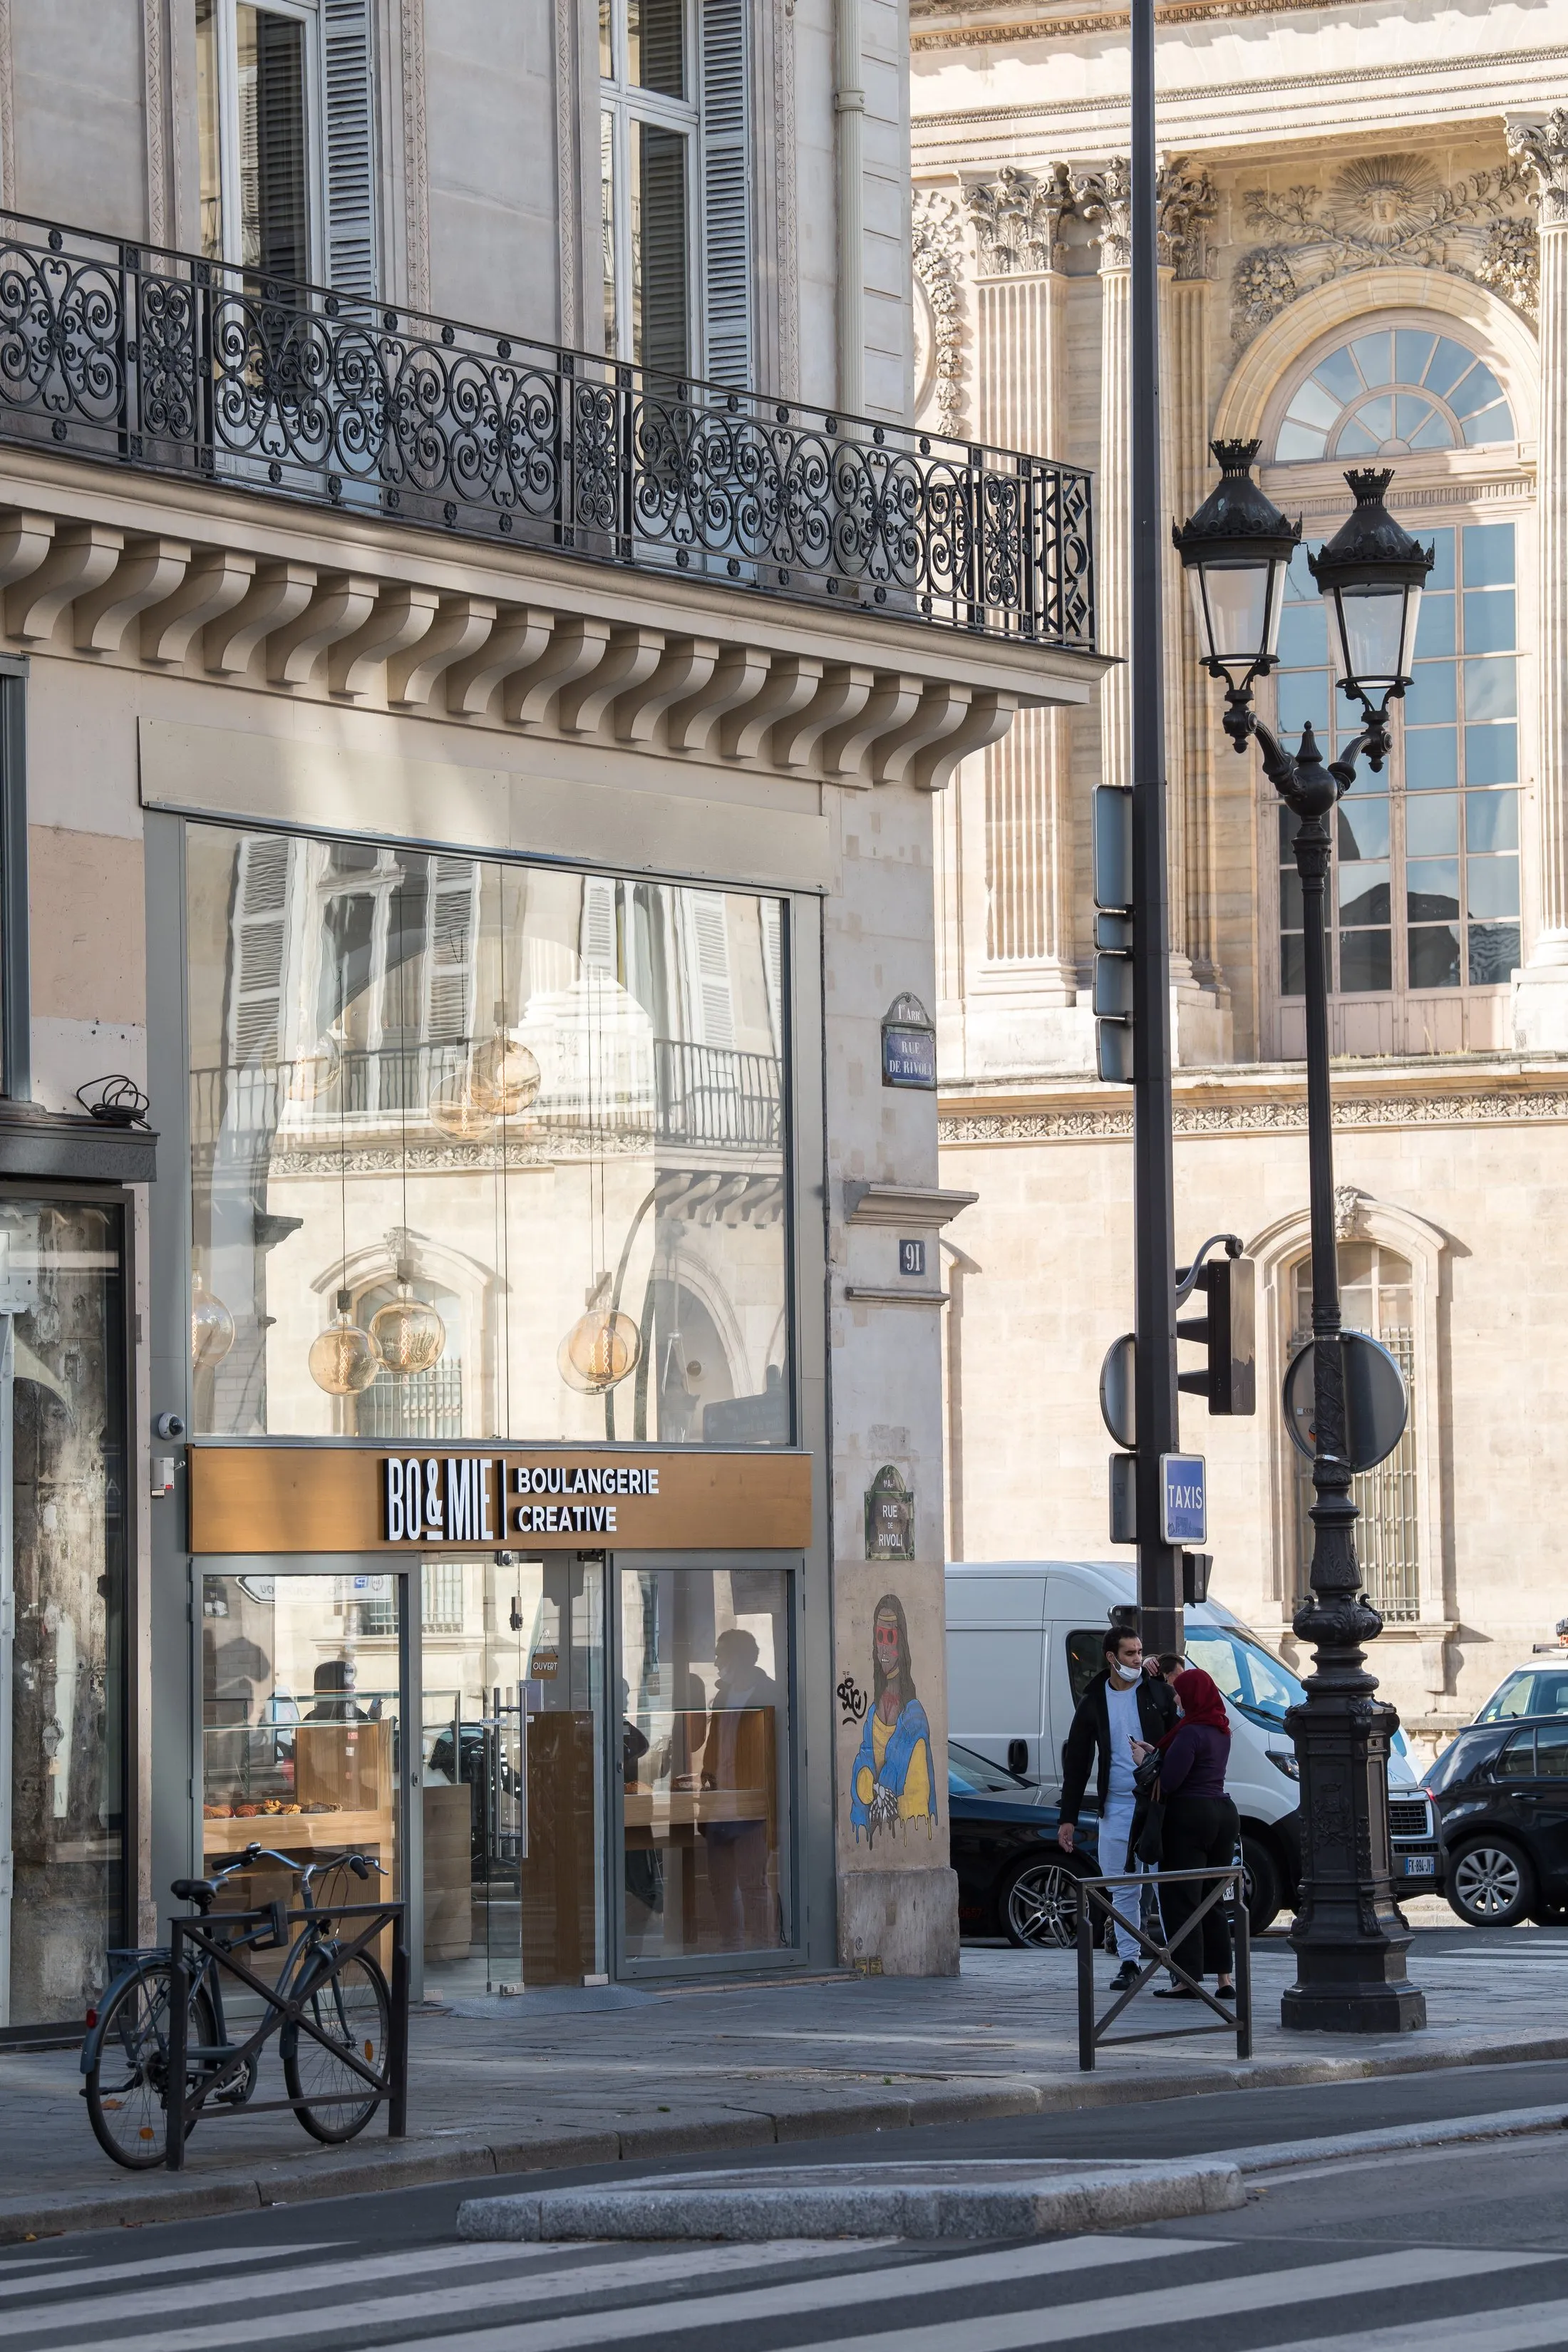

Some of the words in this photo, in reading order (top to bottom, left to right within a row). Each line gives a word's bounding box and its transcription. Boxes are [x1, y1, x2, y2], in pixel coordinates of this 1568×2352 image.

[902, 1041, 920, 1054] RUE
[889, 1060, 901, 1073] DE
[904, 1061, 932, 1076] RIVOLI
[905, 1242, 920, 1272] 91
[515, 1468, 659, 1494] BOULANGERIE
[384, 1458, 493, 1541] BO&MIE
[1167, 1485, 1203, 1510] TAXIS
[515, 1505, 617, 1532] CREATIVE
[882, 1505, 897, 1517] RUE
[879, 1534, 903, 1547] RIVOLI
[532, 1661, 558, 1671] OUVERT
